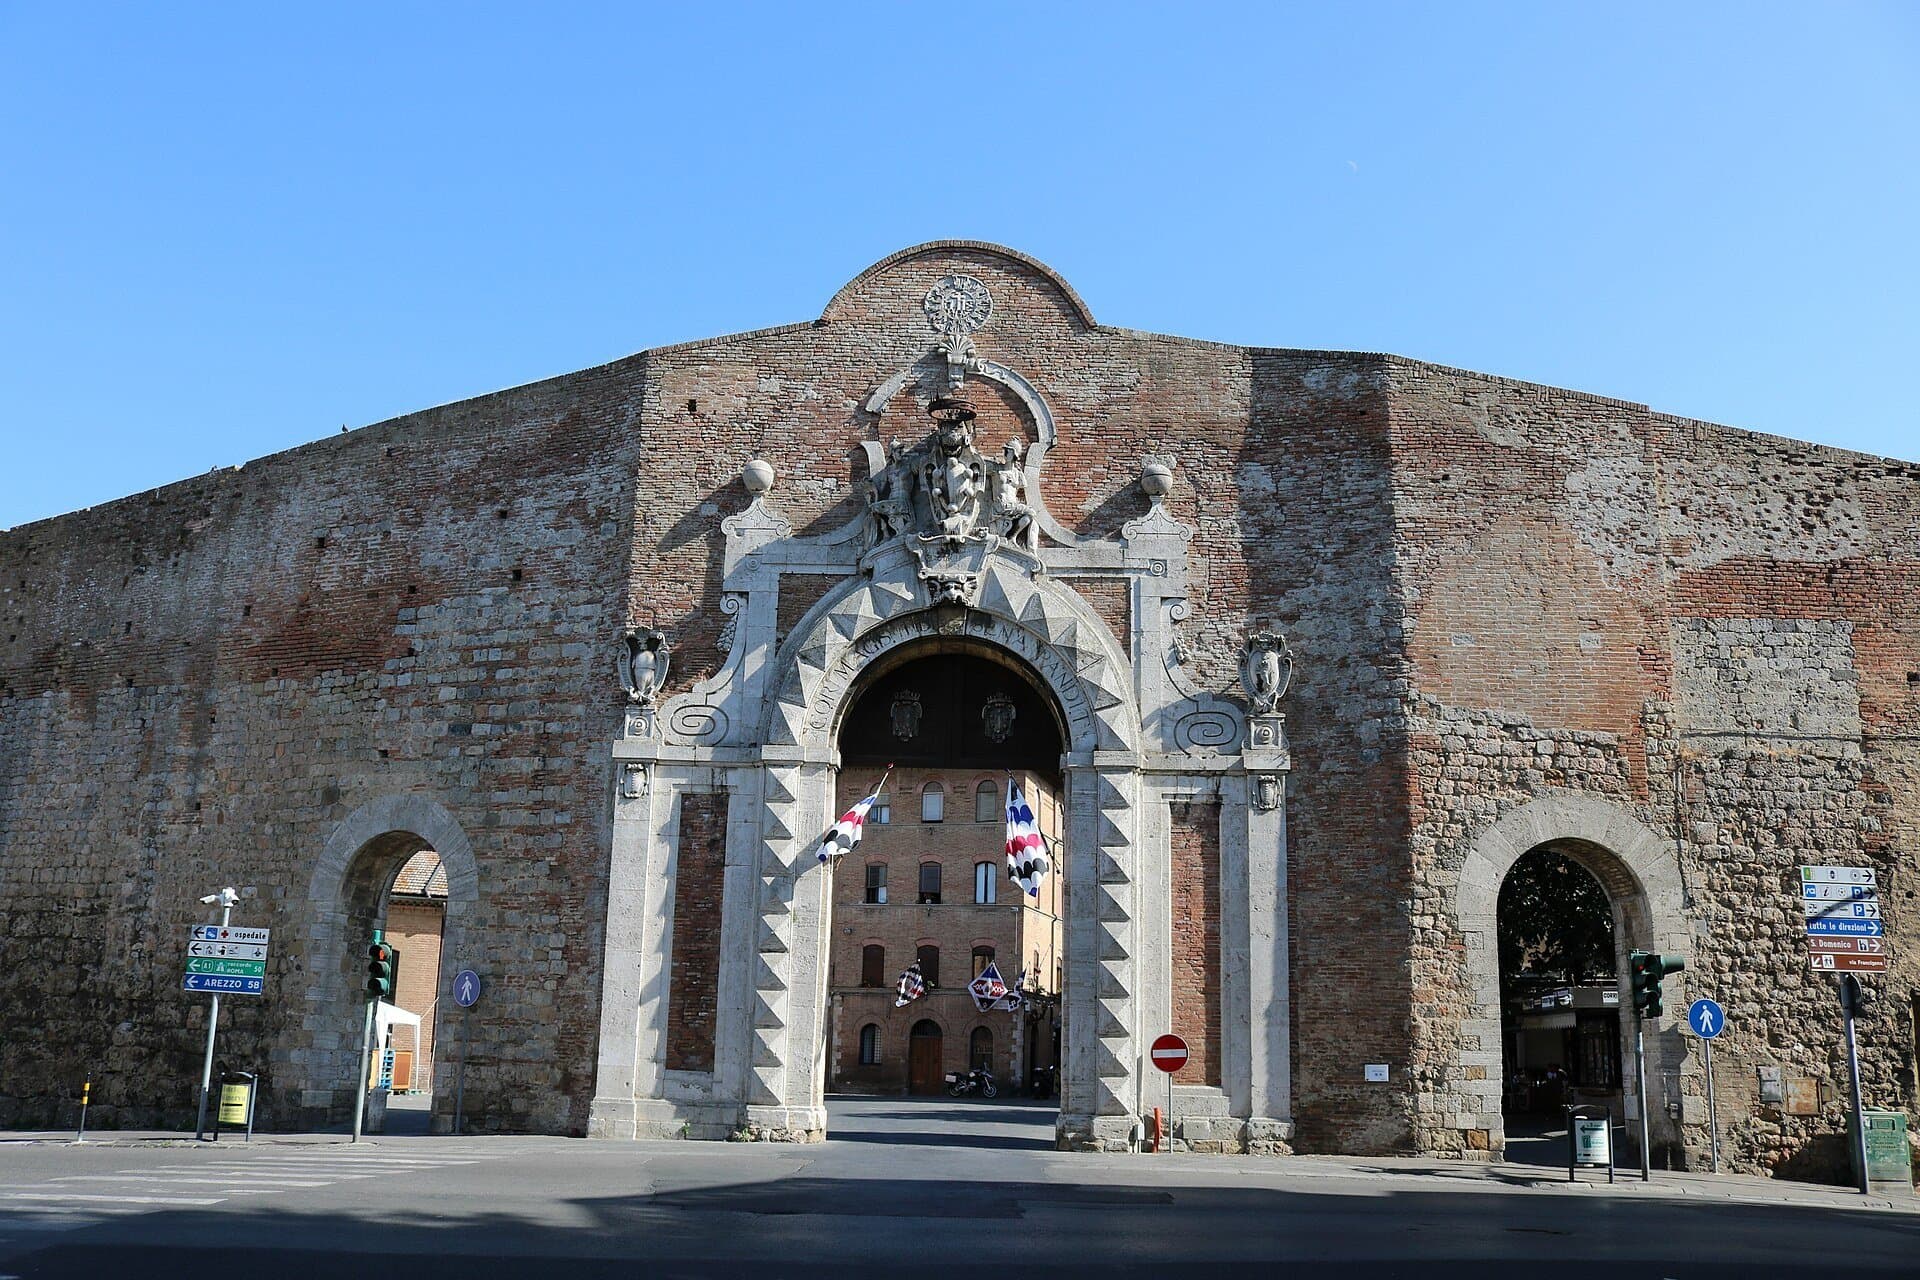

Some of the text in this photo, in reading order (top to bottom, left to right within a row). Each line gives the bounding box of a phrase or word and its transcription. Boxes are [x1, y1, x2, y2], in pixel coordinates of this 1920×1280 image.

[1829, 922, 1836, 930] le
[1838, 922, 1867, 932] direzioni
[234, 931, 266, 940] ospedale
[1818, 939, 1852, 948] Domenico
[203, 978, 260, 989] AREZZO 58
